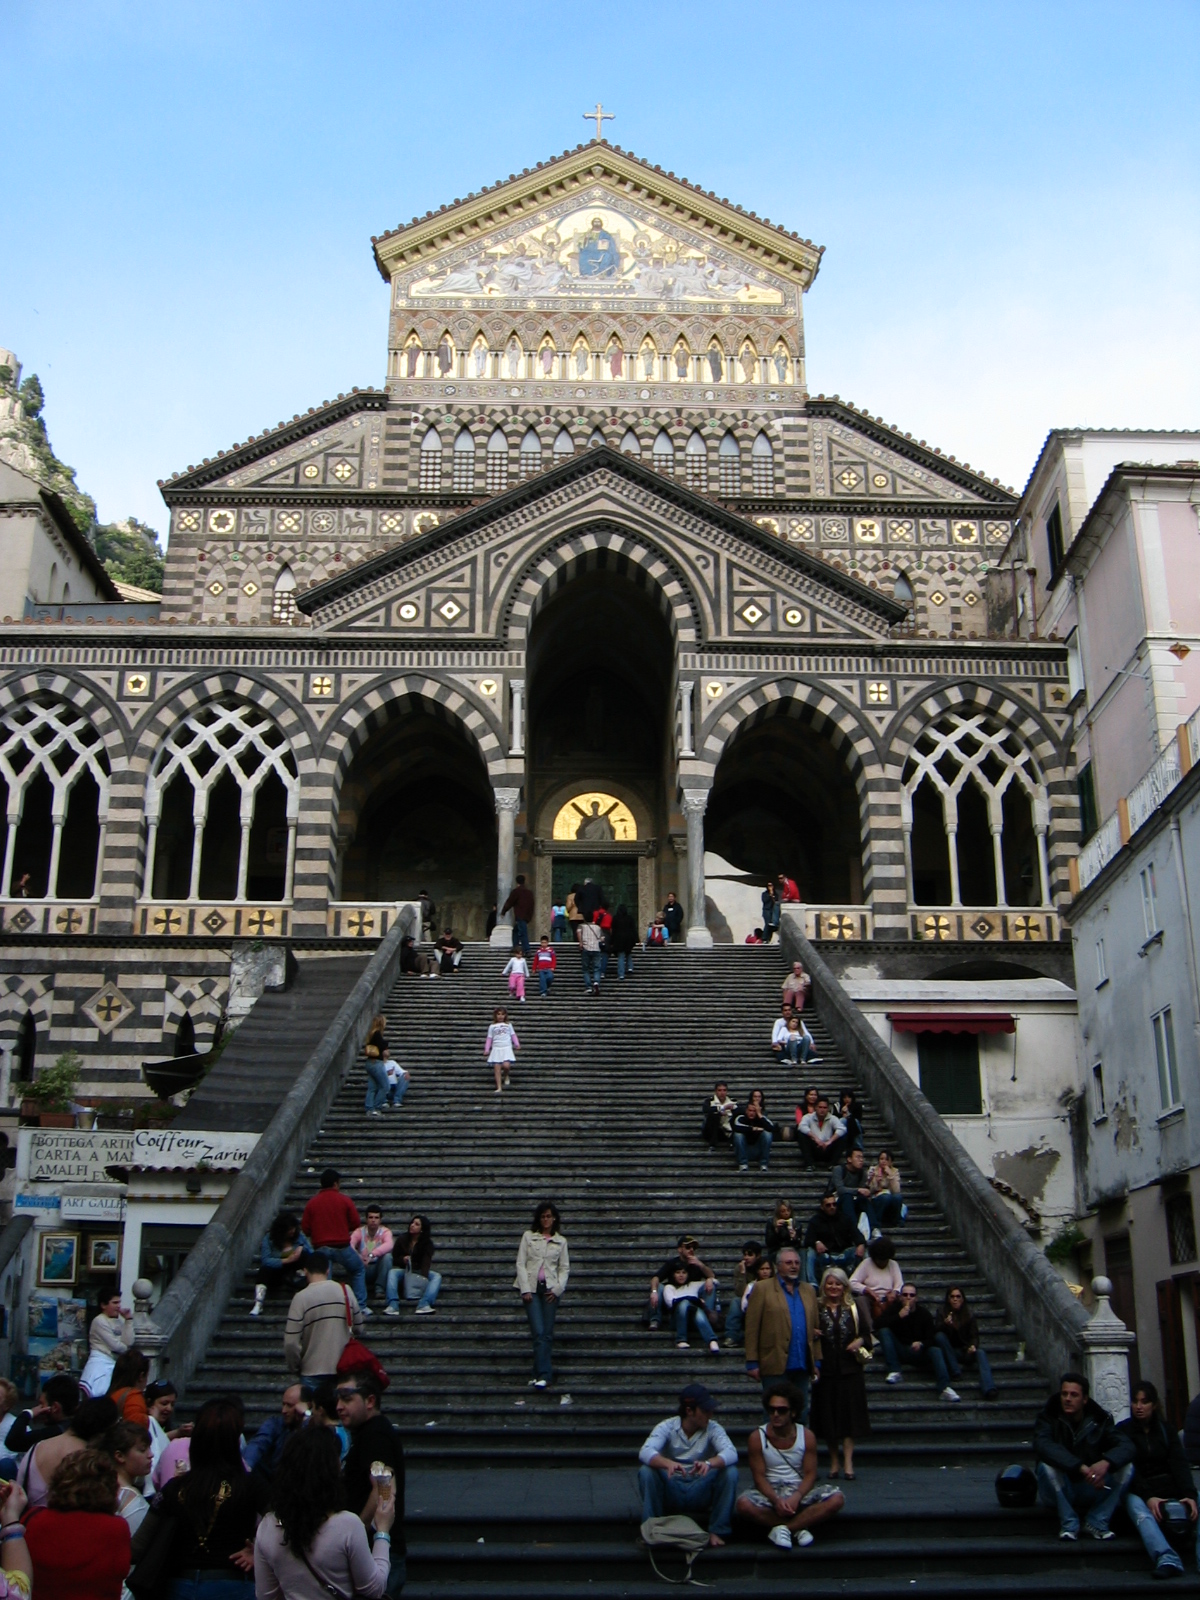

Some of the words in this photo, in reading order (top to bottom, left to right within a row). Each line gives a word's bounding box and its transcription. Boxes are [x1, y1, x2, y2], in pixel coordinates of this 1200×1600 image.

[135, 1131, 205, 1152] Coiffeur
[35, 1148, 81, 1161] CARTA
[89, 1151, 99, 1162] A
[36, 1164, 88, 1176] AMALFI
[64, 1197, 86, 1208] ART
